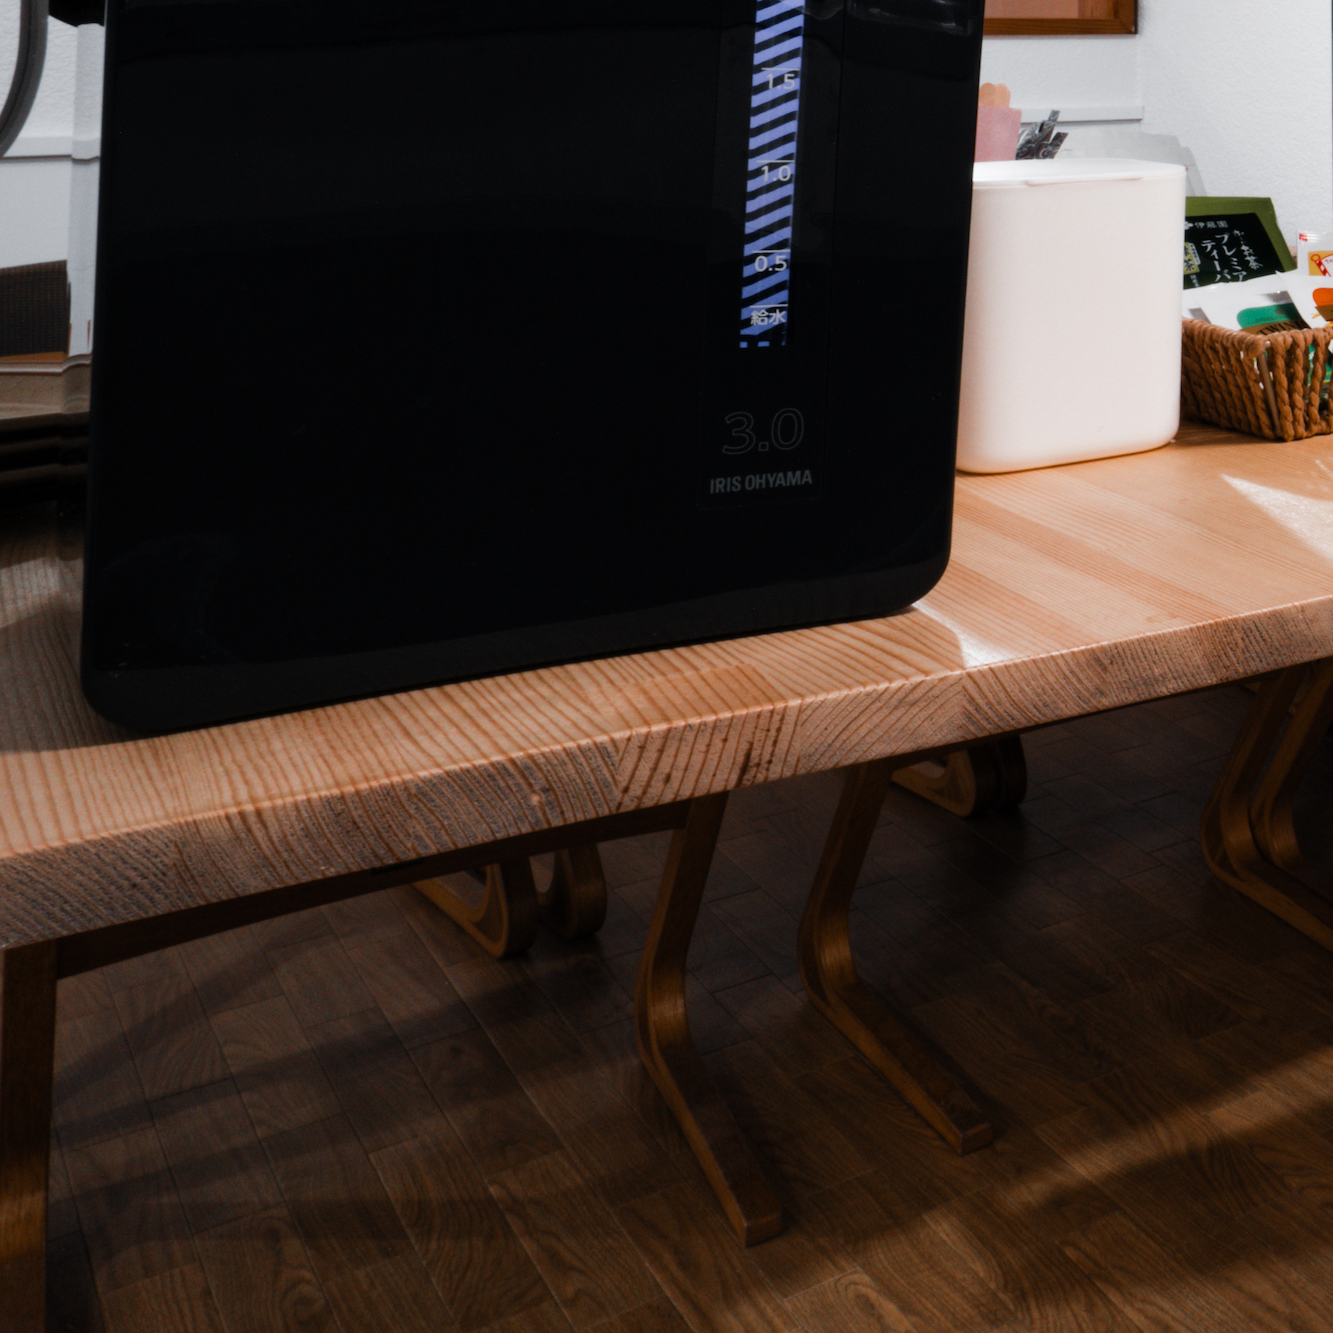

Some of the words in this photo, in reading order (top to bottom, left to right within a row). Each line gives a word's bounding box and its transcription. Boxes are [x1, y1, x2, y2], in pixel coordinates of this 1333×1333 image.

[766, 72, 796, 90] 1.5
[761, 165, 792, 182] 1.0
[754, 254, 788, 272] 0.5
[750, 309, 787, 326] 給水
[722, 407, 805, 455] 3.0
[710, 475, 741, 494] IRIS
[744, 469, 813, 491] OHYAMA
